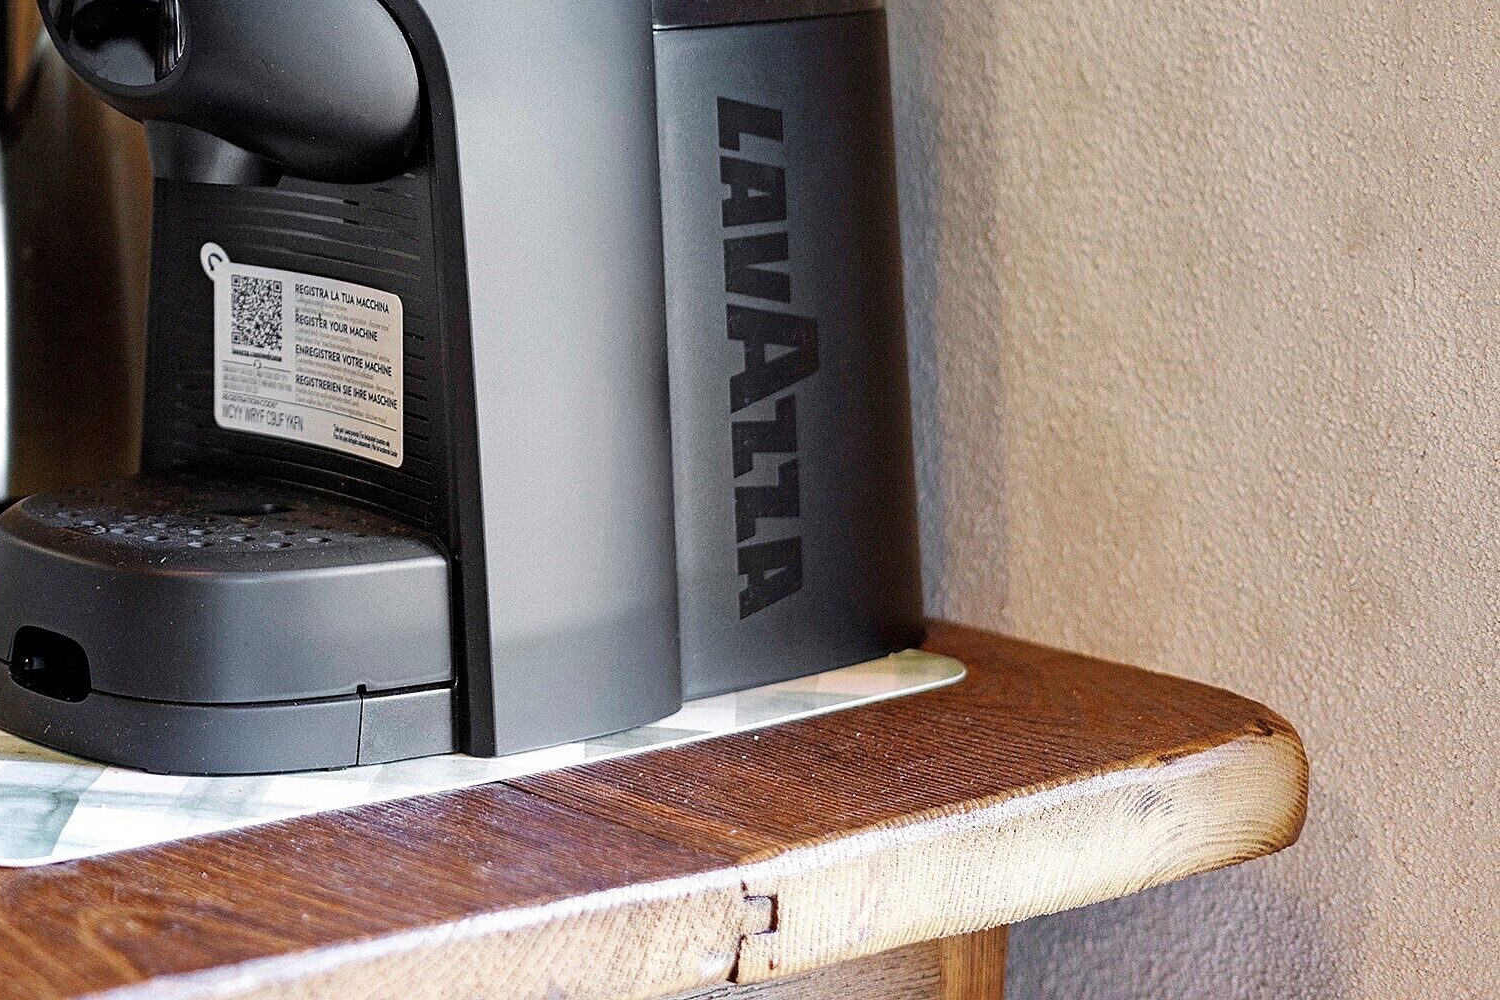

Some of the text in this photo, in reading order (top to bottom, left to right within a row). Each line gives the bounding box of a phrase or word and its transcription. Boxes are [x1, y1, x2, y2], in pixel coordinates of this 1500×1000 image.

[295, 284, 329, 299] REGISTRA
[331, 290, 340, 302] LA
[341, 292, 355, 305] TUA
[356, 297, 390, 314] MACCHINA
[295, 313, 327, 329] REGISTER
[329, 320, 348, 334] YOUR
[349, 326, 378, 341] MACHINE
[295, 344, 340, 362] ENREGISTRER
[342, 354, 363, 368] VOTRE
[364, 360, 392, 377] MACHINE
[717, 96, 820, 620] LAVAZZA
[342, 384, 352, 396] SIE
[353, 387, 367, 401] IHRE
[368, 393, 398, 410] MASCHINE
